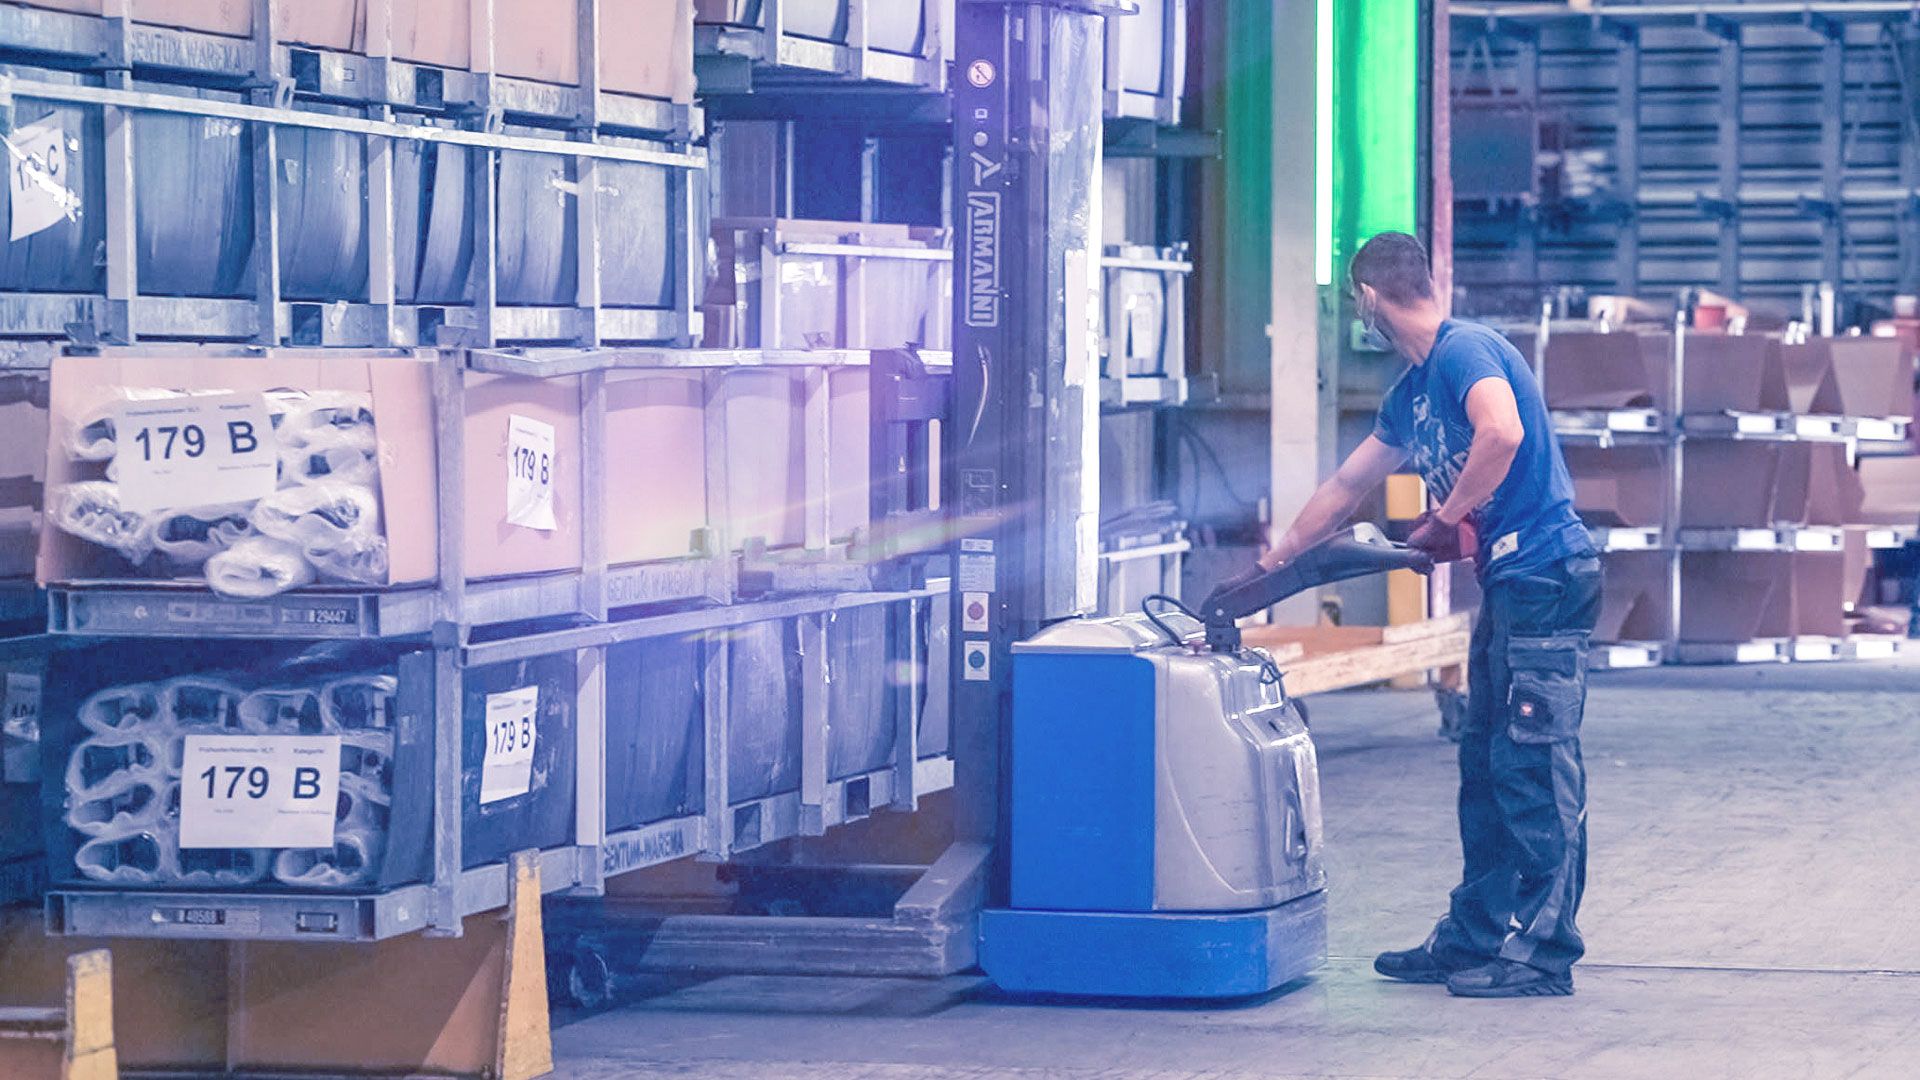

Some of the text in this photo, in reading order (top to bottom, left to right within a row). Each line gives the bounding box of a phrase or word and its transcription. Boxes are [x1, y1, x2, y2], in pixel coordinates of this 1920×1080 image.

[47, 144, 58, 176] C
[971, 200, 995, 322] ARMANNI
[136, 421, 258, 461] 179 B
[514, 446, 536, 481] 179
[493, 716, 531, 754] 179 B
[200, 765, 321, 799] 179 B
